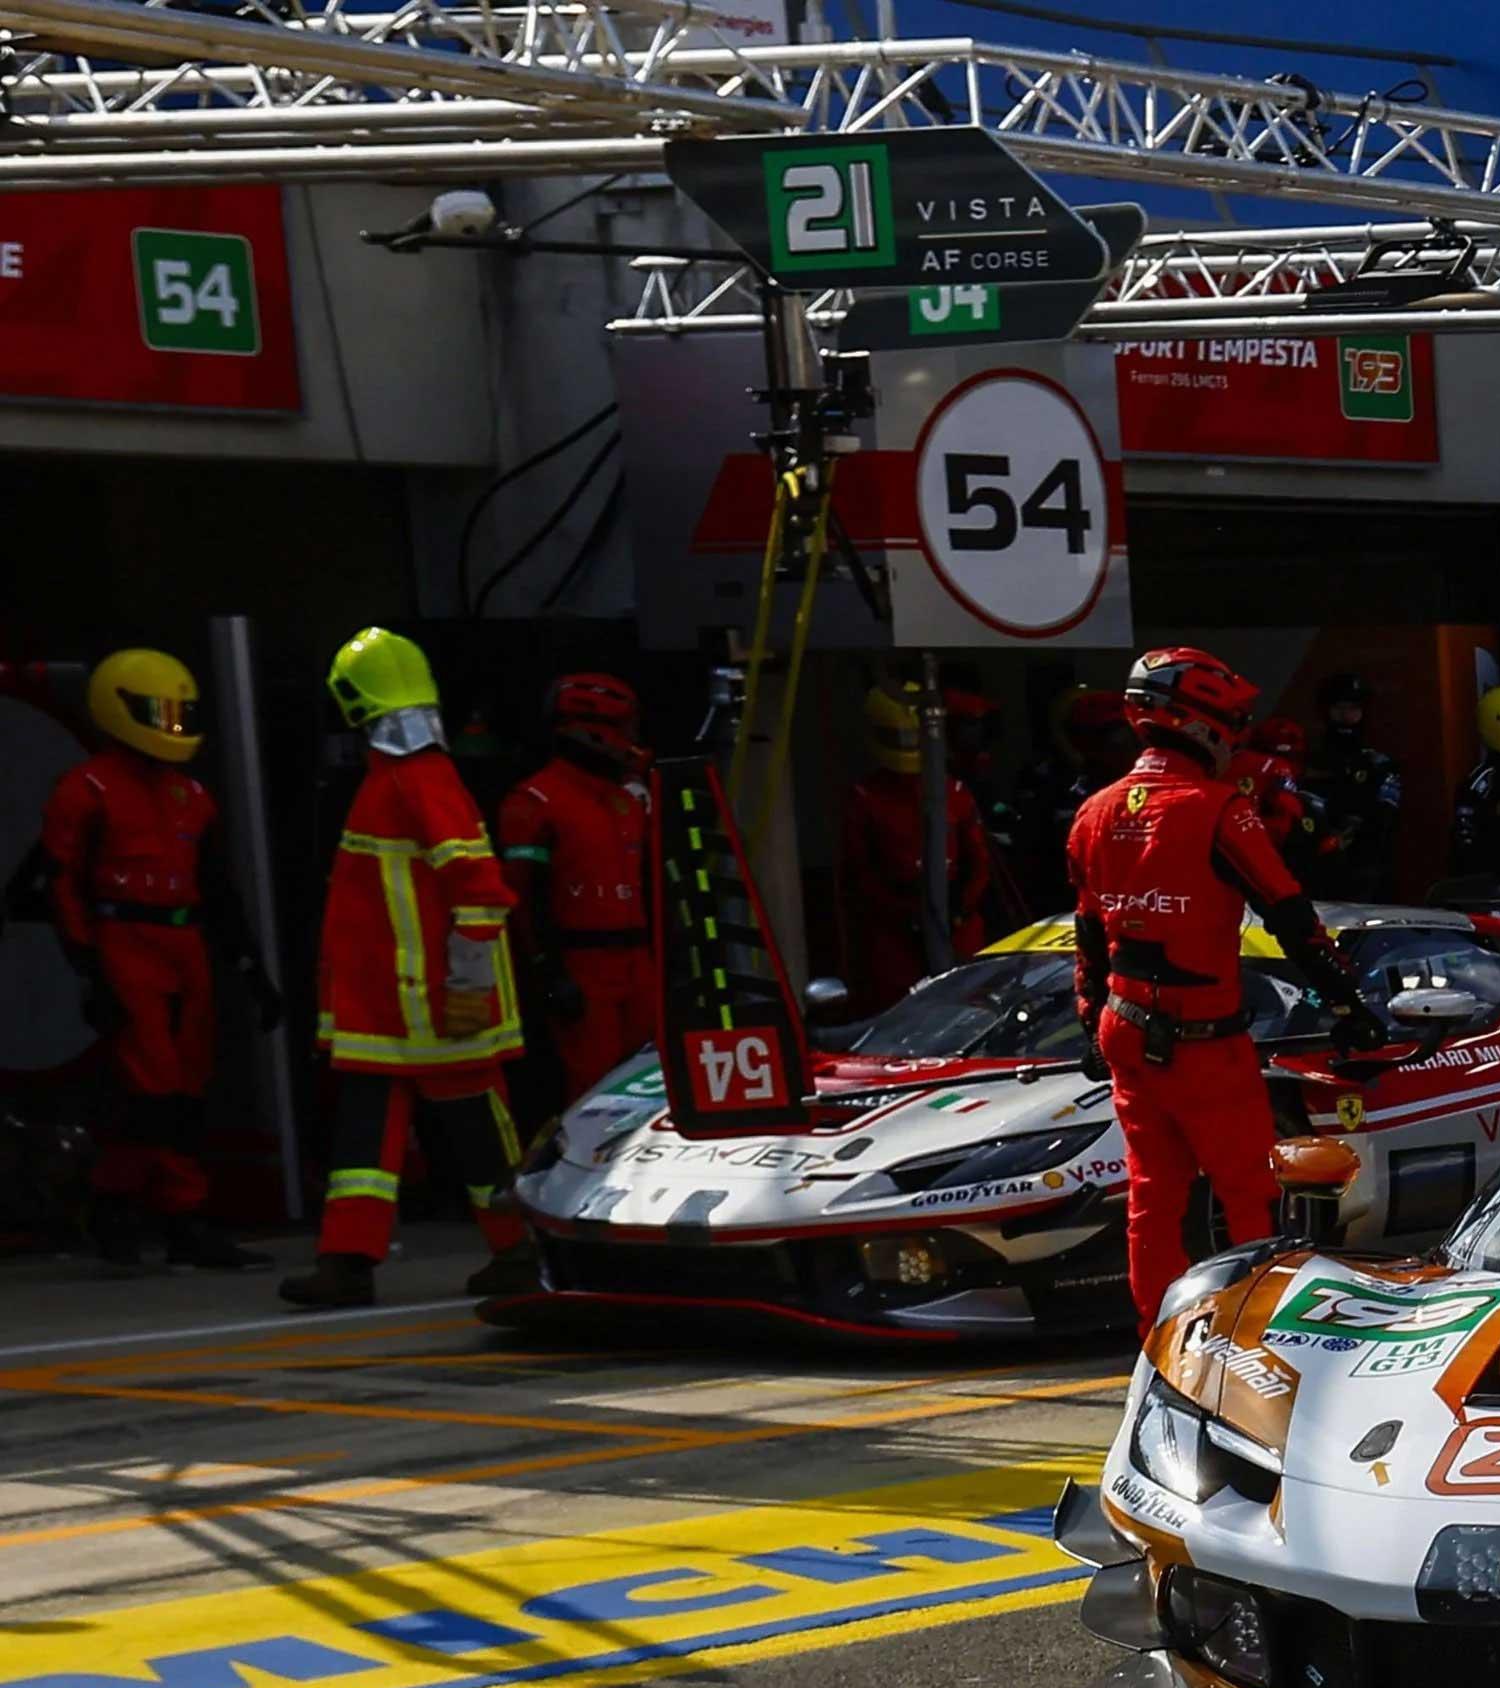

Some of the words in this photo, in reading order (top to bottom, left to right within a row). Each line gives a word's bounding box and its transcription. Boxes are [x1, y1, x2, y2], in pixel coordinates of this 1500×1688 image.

[782, 161, 875, 254] 21
[917, 197, 1046, 222] VISTA
[921, 249, 961, 272] AF
[970, 250, 1050, 270] CORSE
[153, 259, 240, 328] 54
[1197, 340, 1319, 369] TEMPESTA
[1343, 347, 1404, 394] 193
[945, 452, 1093, 555] 54
[699, 1035, 774, 1101] 54
[612, 1141, 824, 1174] VISTAJET
[910, 1179, 1034, 1207] GOODYEAR
[1300, 1286, 1497, 1331] 193
[1261, 1331, 1305, 1346] FIA
[1385, 1338, 1445, 1358] LM
[1368, 1352, 1442, 1373] GT3
[1111, 1474, 1188, 1531] GOODYEAR
